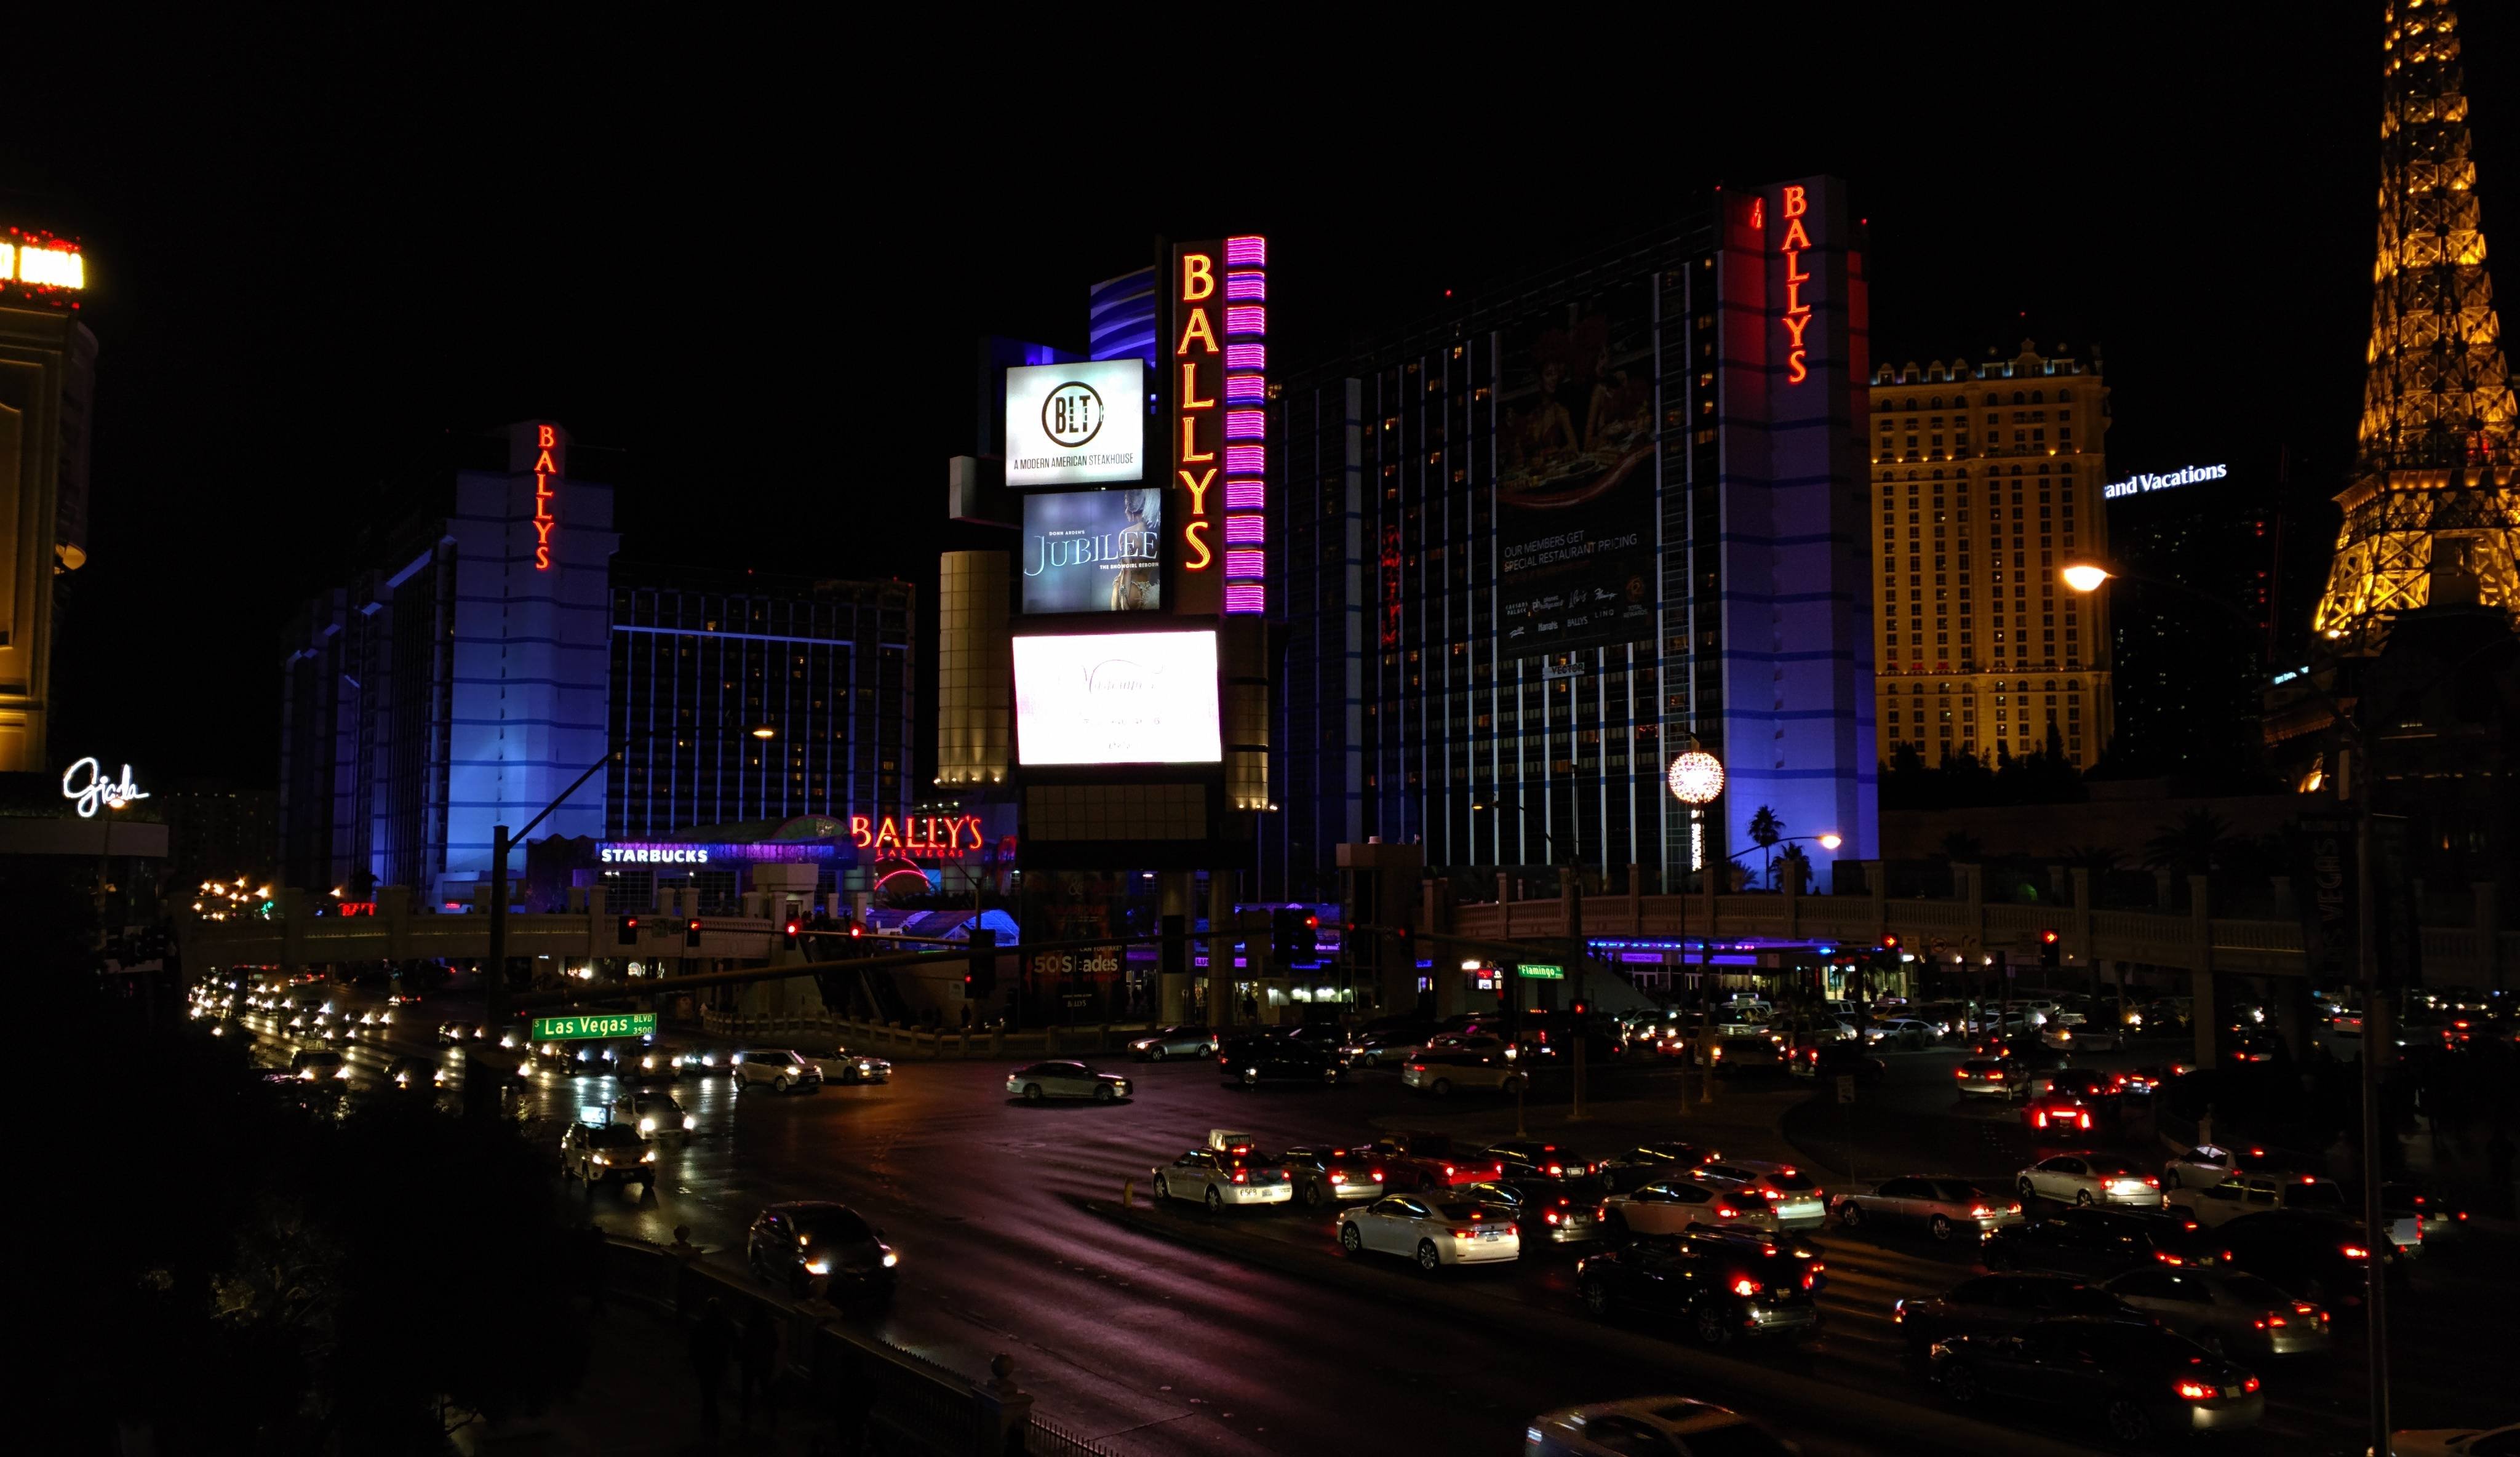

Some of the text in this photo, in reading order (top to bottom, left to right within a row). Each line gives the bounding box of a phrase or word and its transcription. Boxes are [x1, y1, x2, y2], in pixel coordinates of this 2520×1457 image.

[1782, 186, 1811, 383] BALLYS
[1056, 395, 1091, 434] BLT
[1178, 254, 1219, 569] BALLYS
[1014, 453, 1134, 469] A MODERN AMERICAN STEAKHOUSE
[2140, 464, 2227, 492] Vacations
[532, 425, 556, 569] BALLYS
[1024, 530, 1158, 577] JUBILEE
[1504, 557, 1538, 572] SPECIAL
[1539, 542, 1596, 565] RESTAURANT
[1598, 533, 1638, 552] PRICING
[1505, 530, 1585, 558] OUR MEMBERS GET
[63, 757, 150, 817] Giada
[851, 815, 983, 849] BALLY'S
[602, 848, 708, 862] STARBUCKS
[1034, 956, 1058, 973] 50
[1521, 965, 1555, 978] Flamingo
[544, 1020, 574, 1035] Las
[580, 1017, 628, 1036] Vegas
[632, 1026, 653, 1035] 3500
